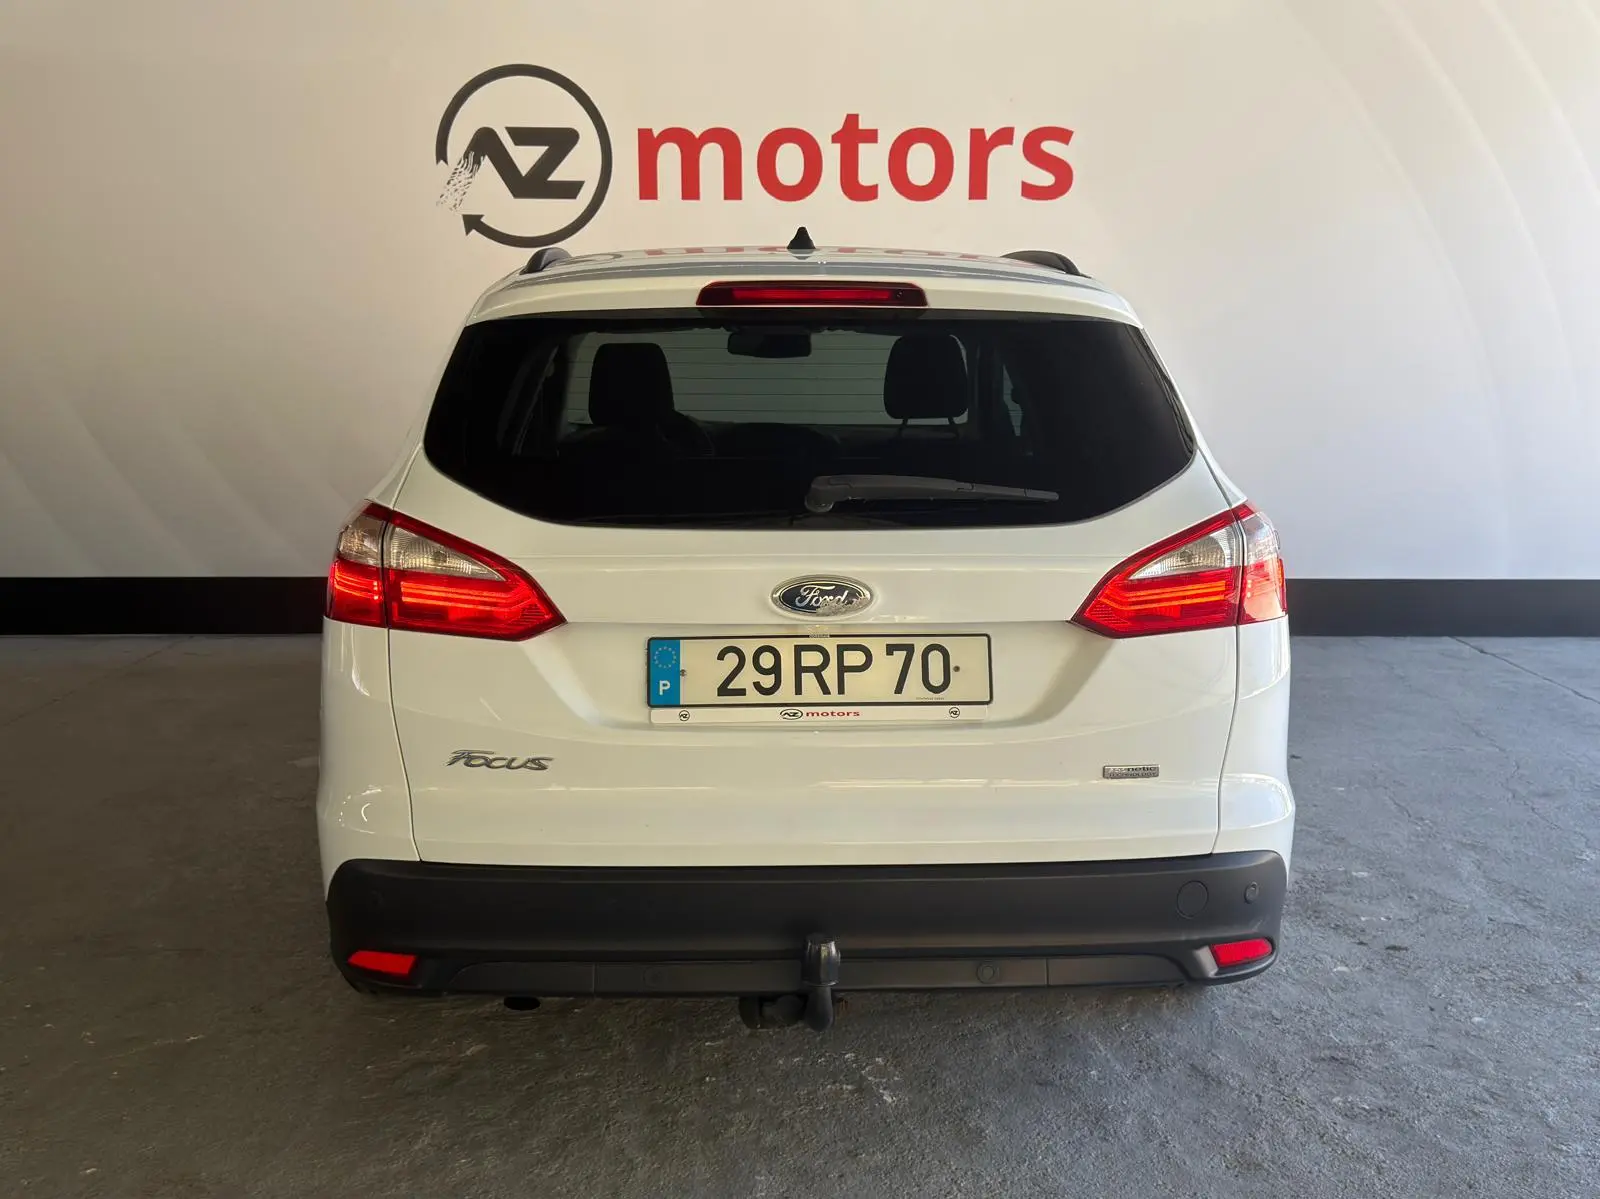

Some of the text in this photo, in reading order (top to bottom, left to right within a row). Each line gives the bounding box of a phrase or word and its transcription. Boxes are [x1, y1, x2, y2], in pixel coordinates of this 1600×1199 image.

[636, 113, 1075, 203] motors
[795, 585, 849, 607] Ford
[658, 680, 671, 696] P
[716, 643, 951, 697] 29 RP 70
